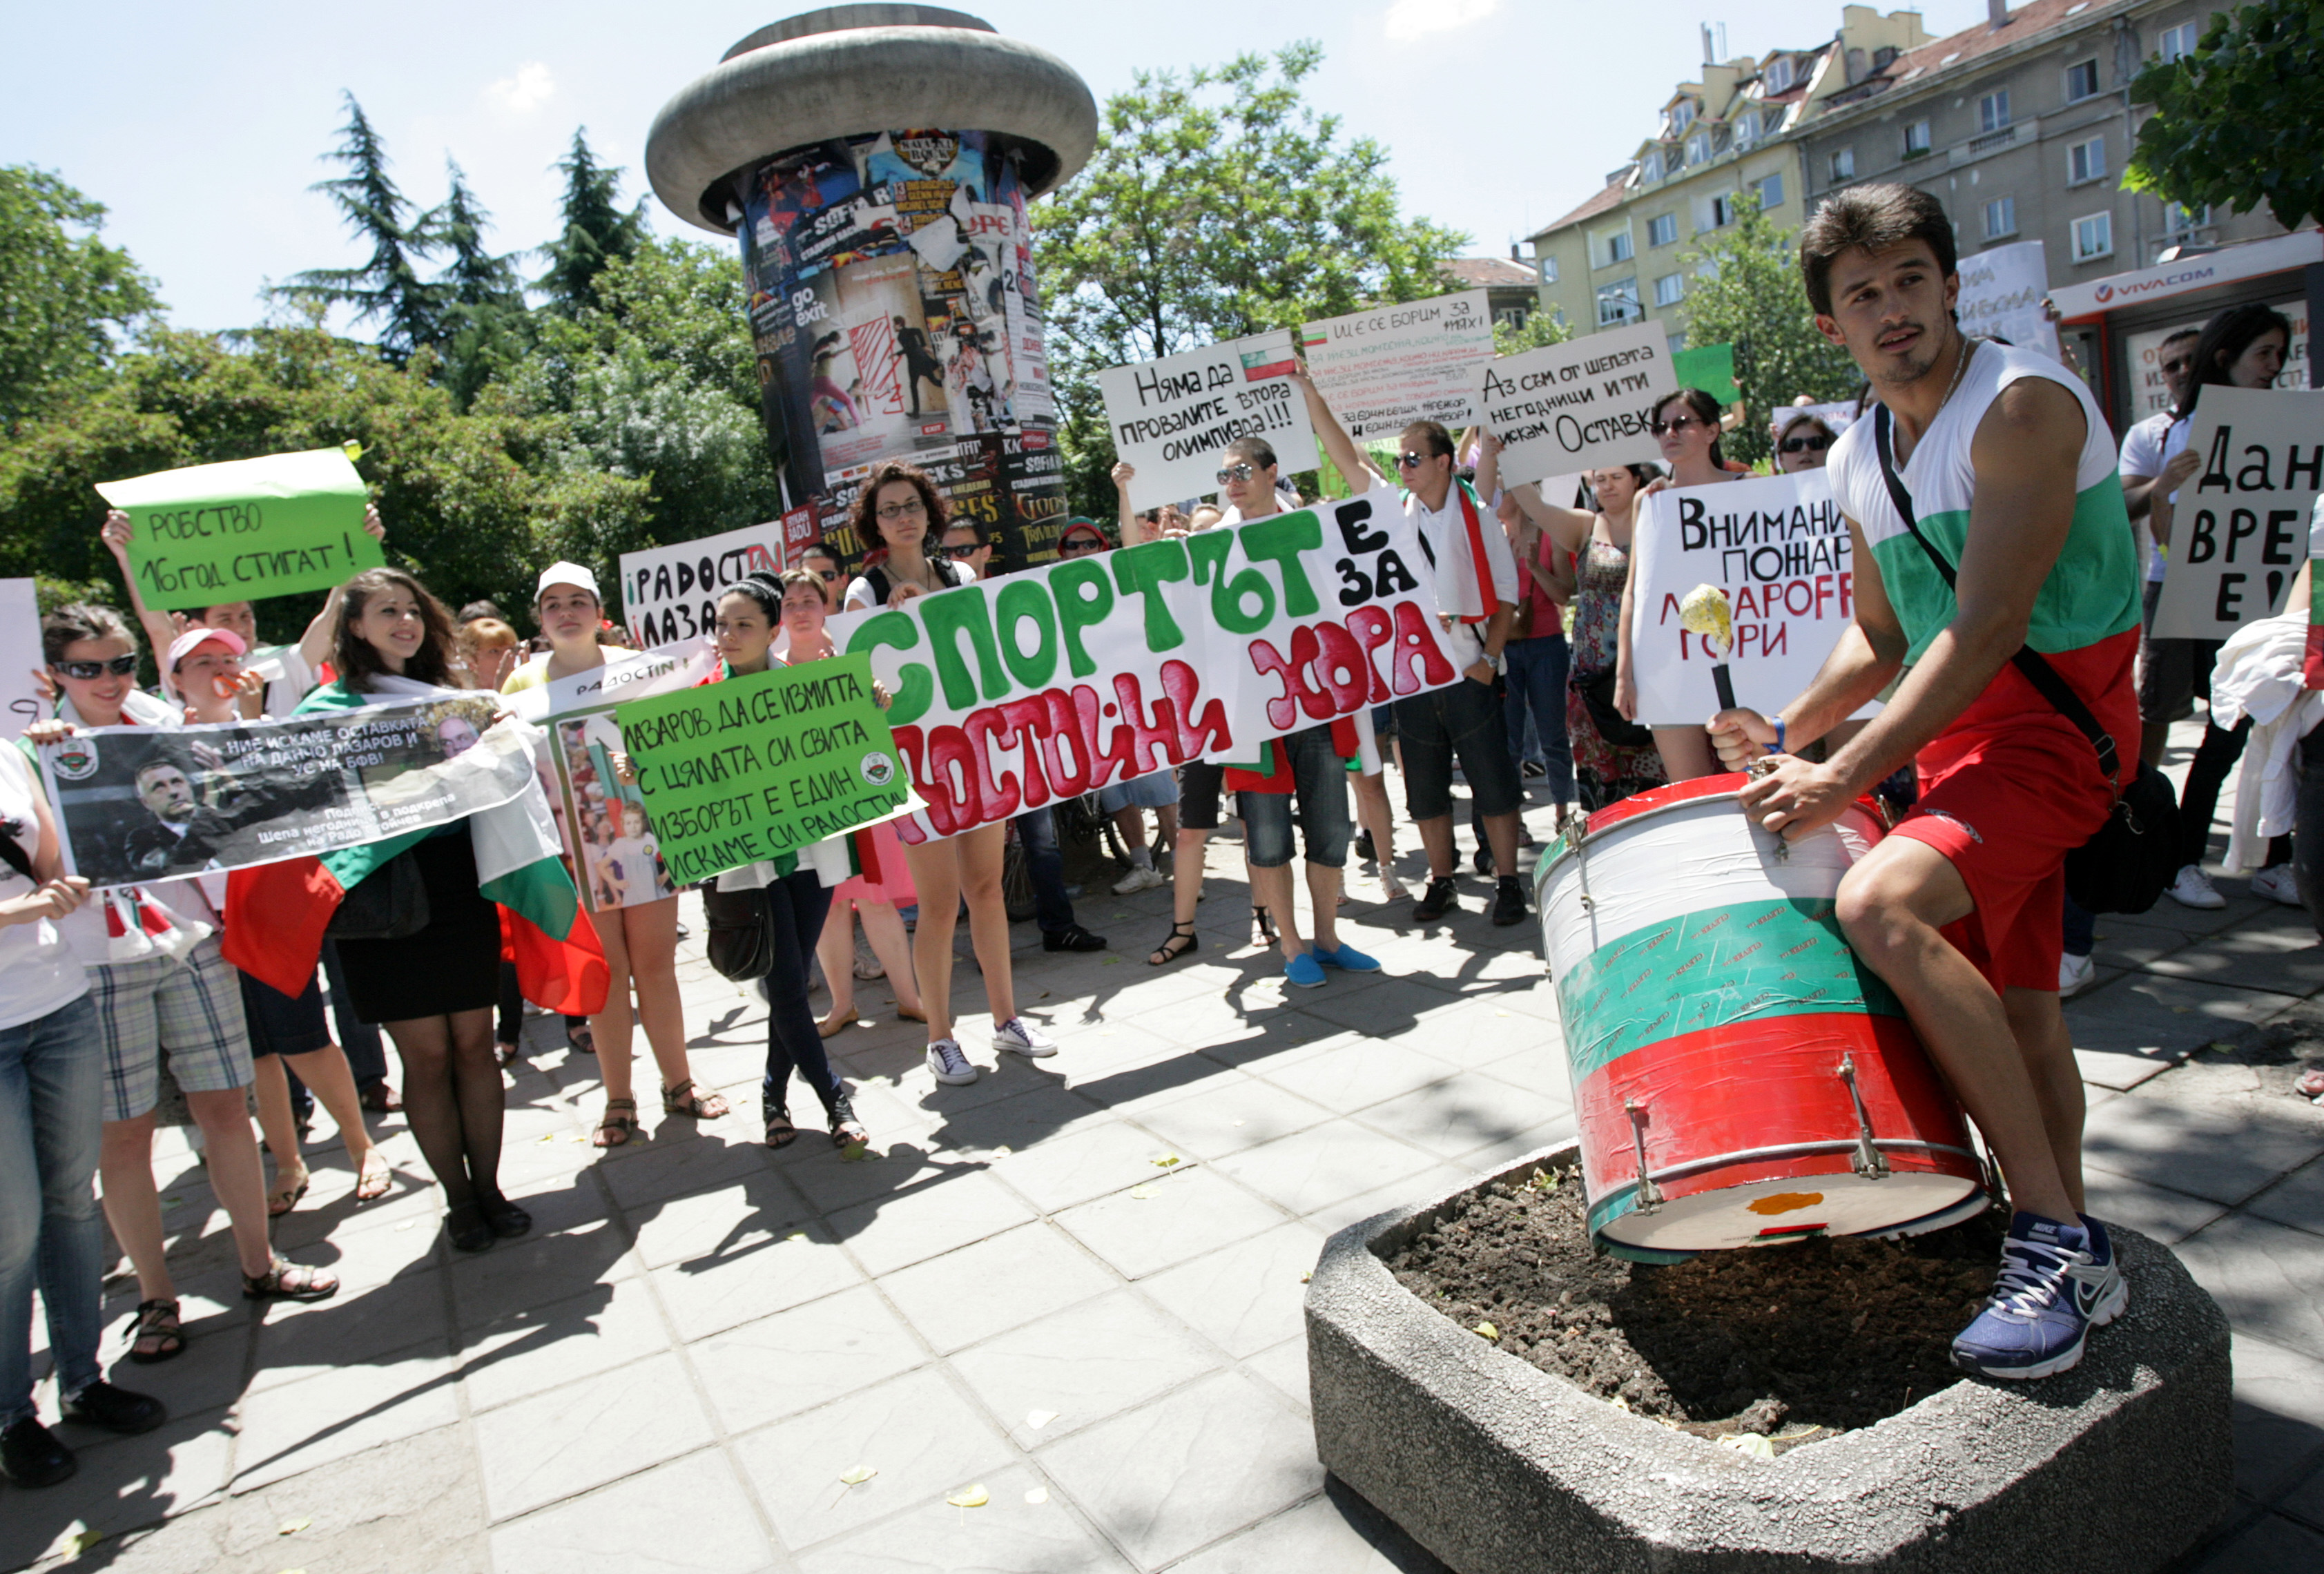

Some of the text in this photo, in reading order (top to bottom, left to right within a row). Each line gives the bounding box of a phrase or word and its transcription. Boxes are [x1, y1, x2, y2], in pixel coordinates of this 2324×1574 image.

[900, 139, 952, 150] KAVANA
[2118, 266, 2214, 295] VIVACOM
[792, 286, 814, 308] go
[795, 301, 829, 327] exit
[1368, 318, 1386, 331] СЕ
[1391, 308, 1441, 328] БОРИМ
[924, 425, 942, 433] EXIT
[1556, 407, 1655, 452] ОСТАВК
[149, 503, 262, 541] РОБСТВО
[1679, 497, 1852, 552] ВНИМАНИ
[2187, 508, 2313, 565] ВРЕ
[1722, 534, 1852, 583] ПОЖАР
[1337, 549, 1418, 606] ЗА
[844, 500, 1388, 726] СПОРТЪТ Е
[624, 672, 864, 752] ЛАЗАРОВ ДА СЕ ИЗМИТА
[889, 601, 1455, 846] ДОСТОЙНИ ХОРА
[226, 715, 429, 755] НИЕ ИСКАМЕ ОСТАВКАТА
[270, 745, 328, 766] ДАНЧО
[331, 735, 404, 755] ЛАЗАРОВ
[320, 759, 344, 772] НА
[345, 752, 384, 769] БФВ!
[660, 744, 762, 790] ЦЯЛАТА
[767, 735, 796, 767] СИ
[801, 719, 870, 759] СВИТА
[258, 826, 299, 844] Шепа
[391, 792, 456, 817] подкрепа
[650, 793, 754, 845] ИЗБОРЪТ
[764, 786, 784, 816] Е
[790, 766, 858, 810] ЕДИН
[664, 833, 765, 882] ИСКАМЕ
[766, 822, 802, 850] СИ
[1701, 913, 1730, 935] CLEVER
[1758, 906, 1787, 925] CLEVER
[1647, 926, 1674, 950] CLEVER
[1789, 937, 1818, 955] CLEVER
[1675, 952, 1705, 976] CLEVER
[1733, 941, 1763, 963] CLEVER
[1627, 968, 1653, 993] CLEVER
[1739, 992, 1770, 1013] CLEVER
[1644, 1010, 1671, 1036] CLEVER
[2031, 1222, 2057, 1234] NIKE
